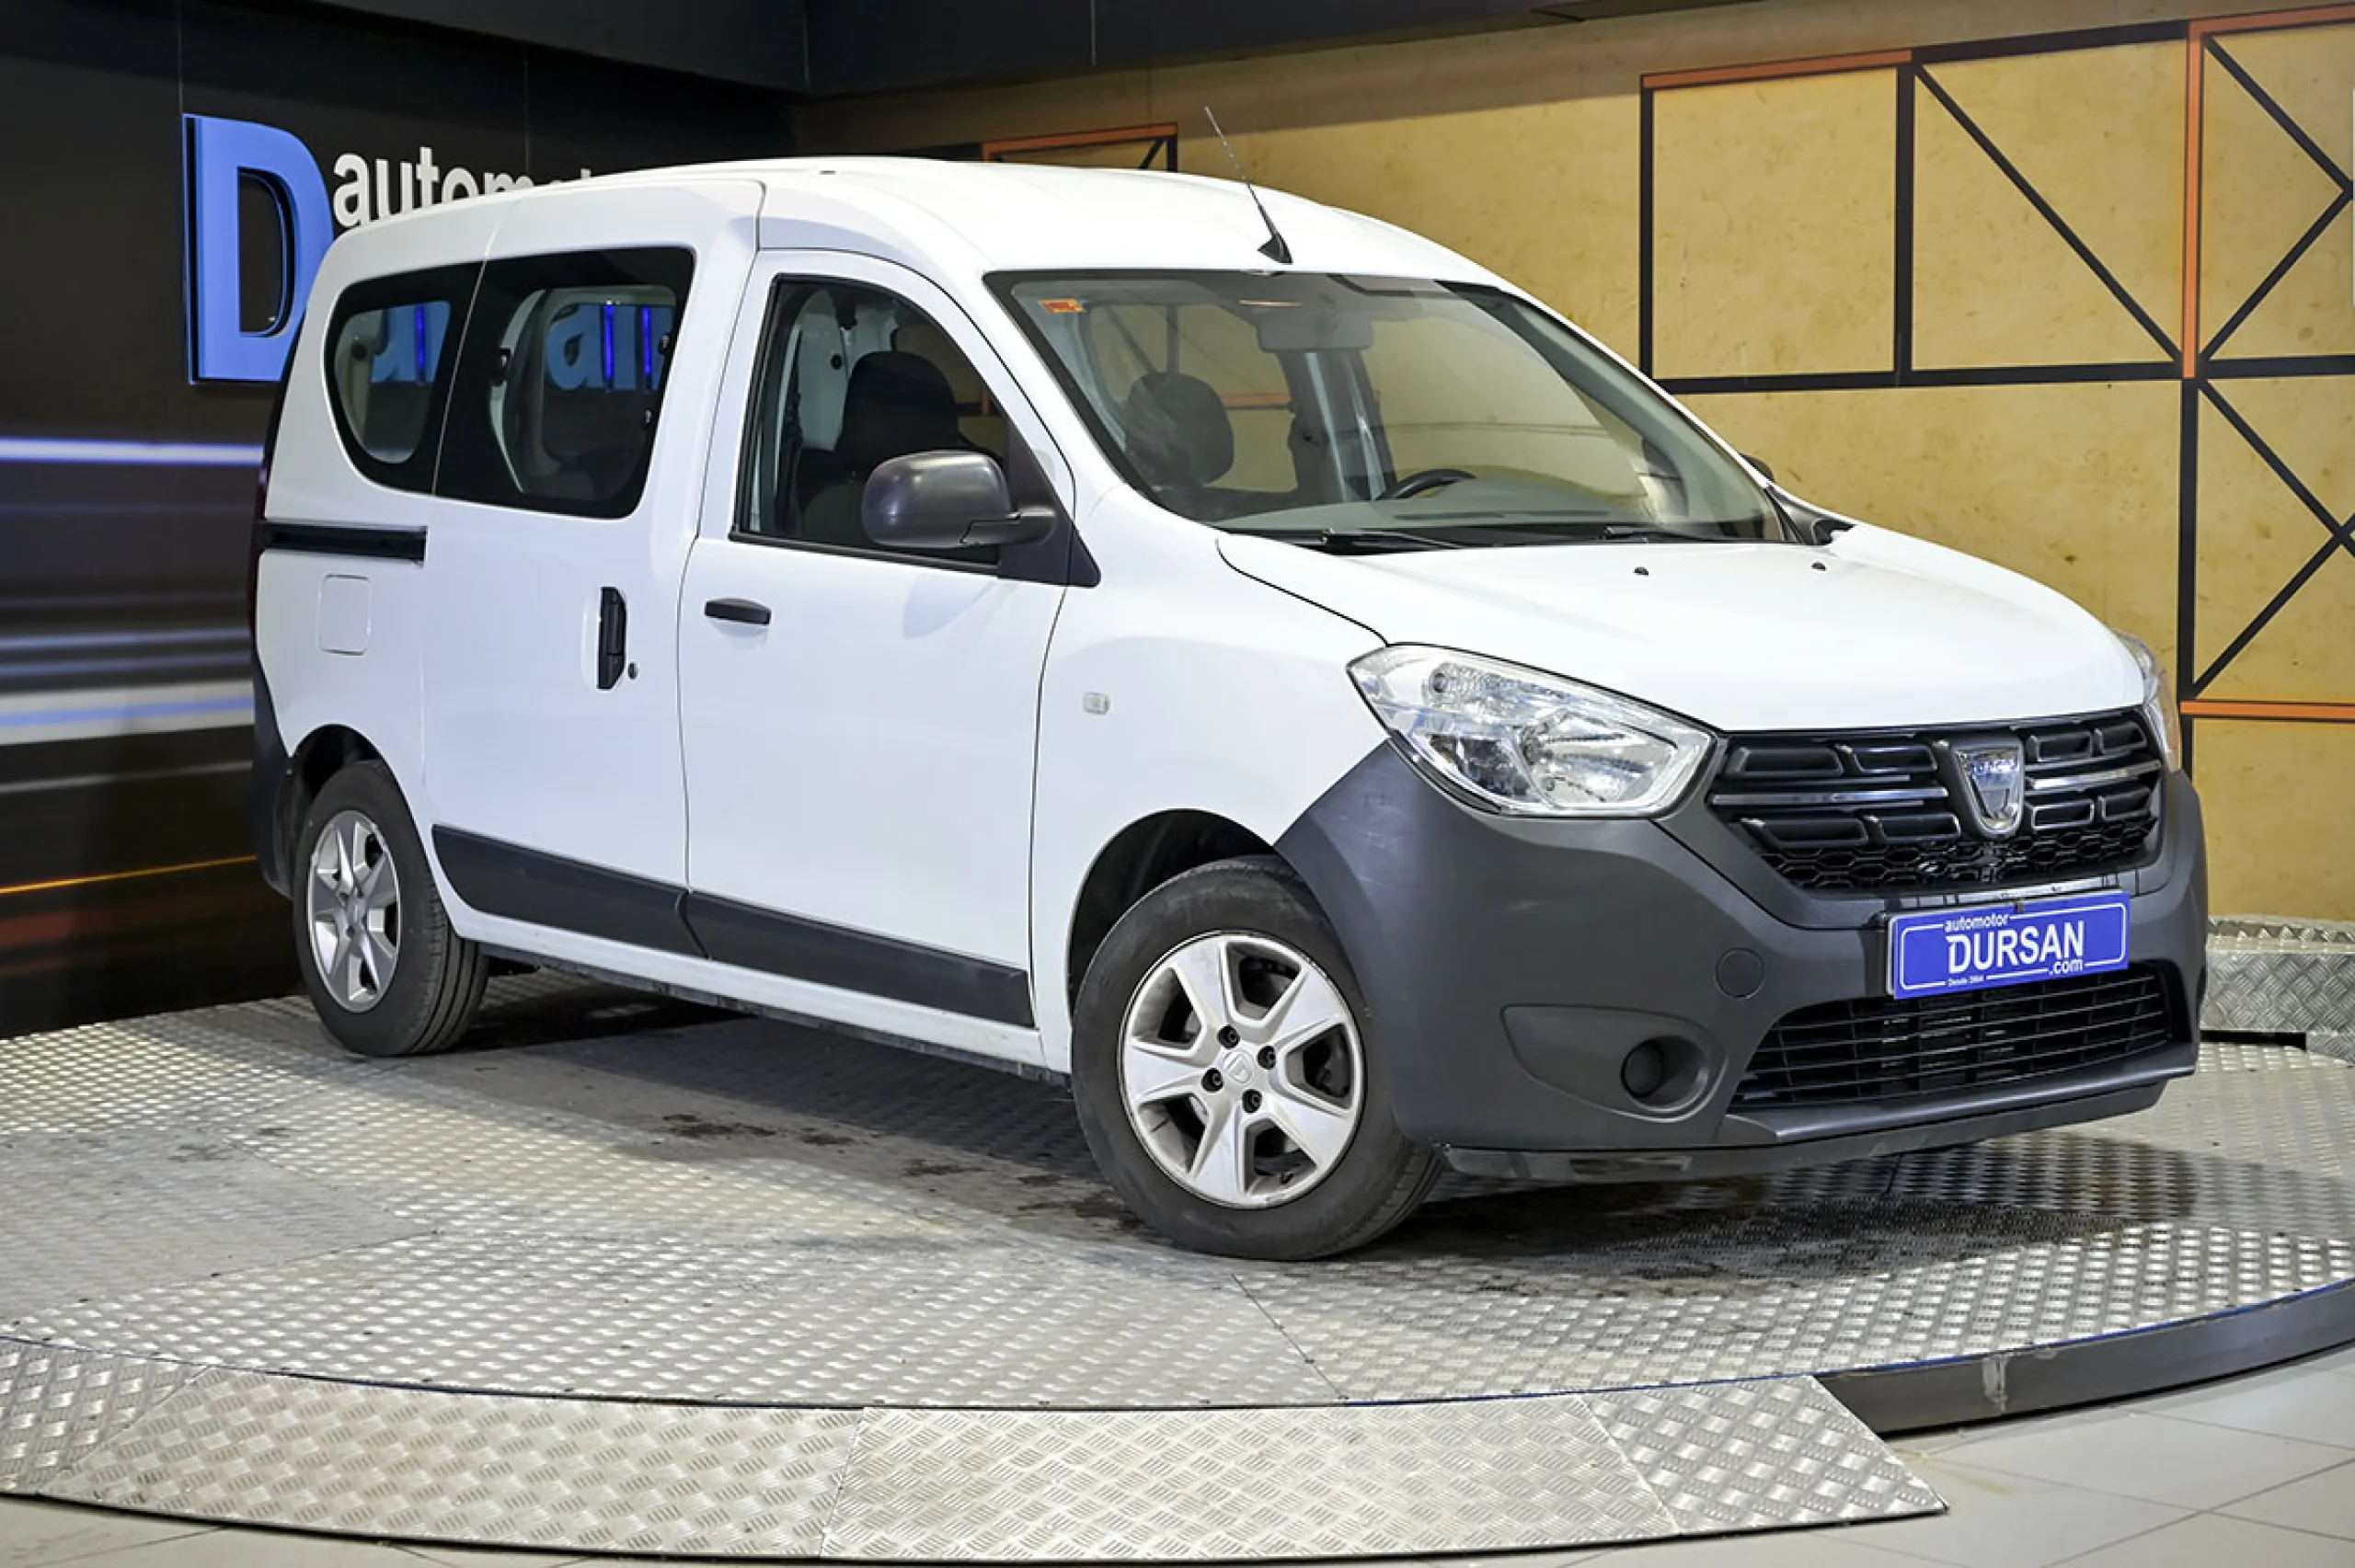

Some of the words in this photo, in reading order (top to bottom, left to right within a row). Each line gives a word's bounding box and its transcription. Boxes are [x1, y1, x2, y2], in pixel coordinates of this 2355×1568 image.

[1944, 913, 2009, 933] automotor
[1945, 921, 2085, 974] DURSAN
[2049, 958, 2084, 975] .com
